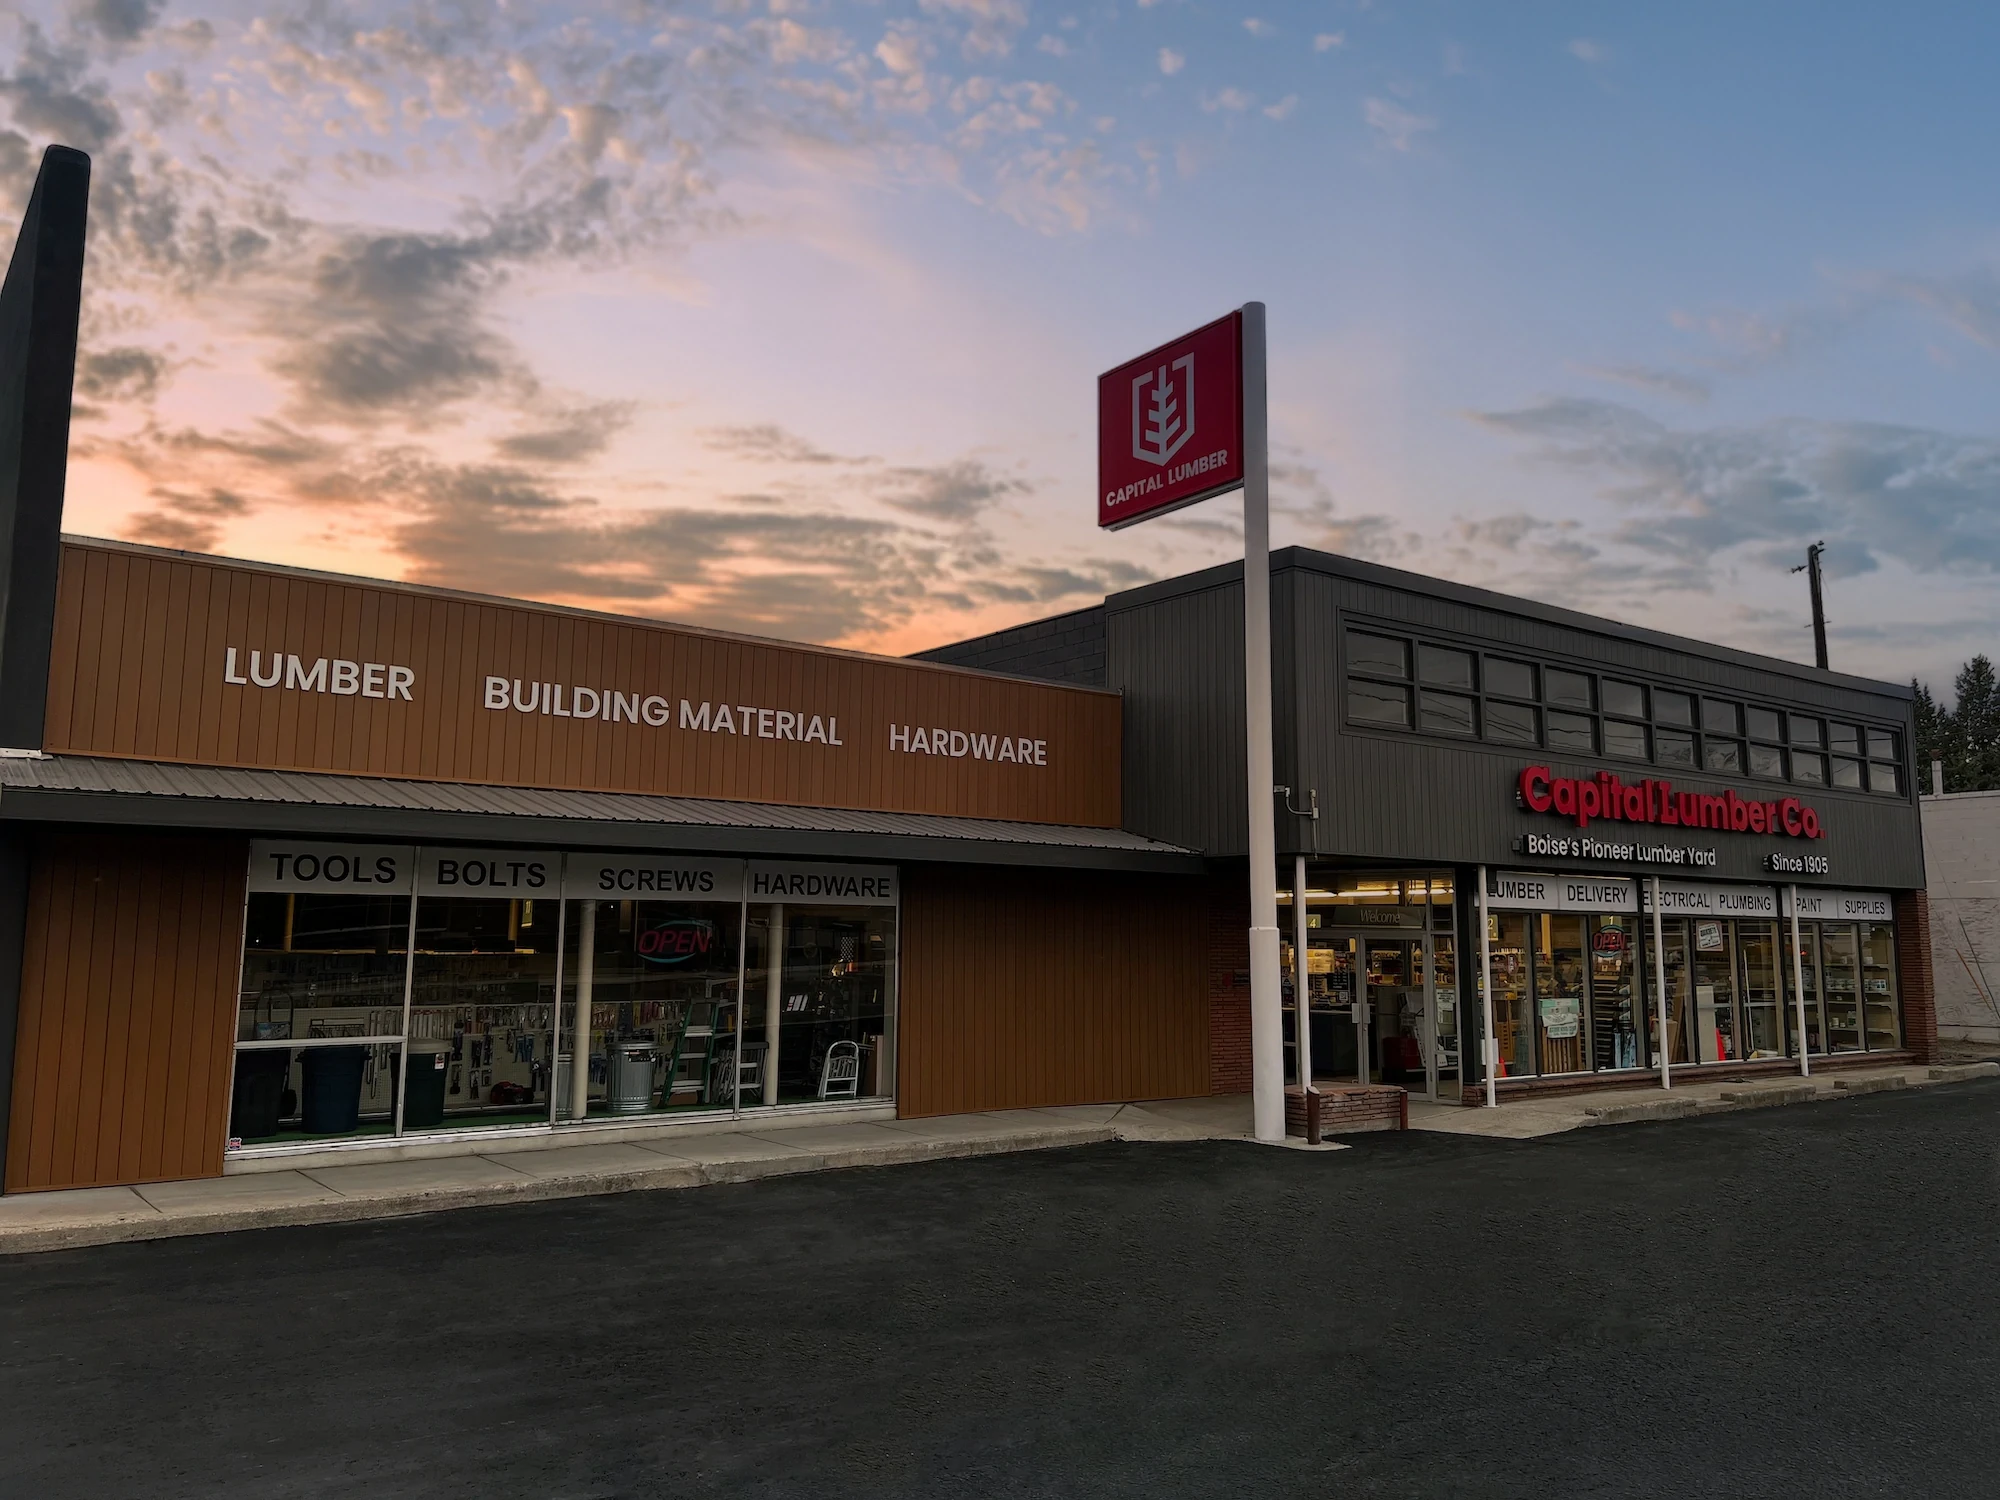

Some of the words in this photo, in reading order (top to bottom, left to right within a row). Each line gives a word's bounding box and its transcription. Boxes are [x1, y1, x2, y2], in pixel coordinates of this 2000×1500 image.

[1105, 473, 1164, 507] CAPITAL
[1168, 449, 1228, 486] LUMBER
[224, 647, 416, 702] LUMBER
[484, 675, 670, 727] BUILDING
[679, 699, 843, 746] MATERIAL
[889, 723, 1048, 766] HARDWARE
[1519, 765, 1655, 828] Capital
[1655, 780, 1776, 835] Lumber
[1777, 797, 1826, 839] Co.
[1528, 834, 1579, 857] Boise's
[1582, 838, 1634, 861] Pioneer
[1637, 842, 1684, 864] Lumber
[1686, 847, 1717, 867] Yard
[269, 853, 397, 884] TOOLS
[437, 860, 547, 888] BOLTS
[1772, 854, 1802, 872] Since
[1804, 856, 1829, 874] 1905
[598, 868, 714, 892] SCREWS
[753, 873, 891, 898] HARDWARE
[1567, 885, 1628, 903] DELIVERY
[1719, 894, 1771, 911] PLUMBING
[1796, 897, 1822, 912] PAINT
[1360, 908, 1400, 923] Welcome
[1845, 900, 1886, 915] SUPPLIES
[638, 929, 713, 954] OPEN
[1592, 932, 1627, 951] OPEN
